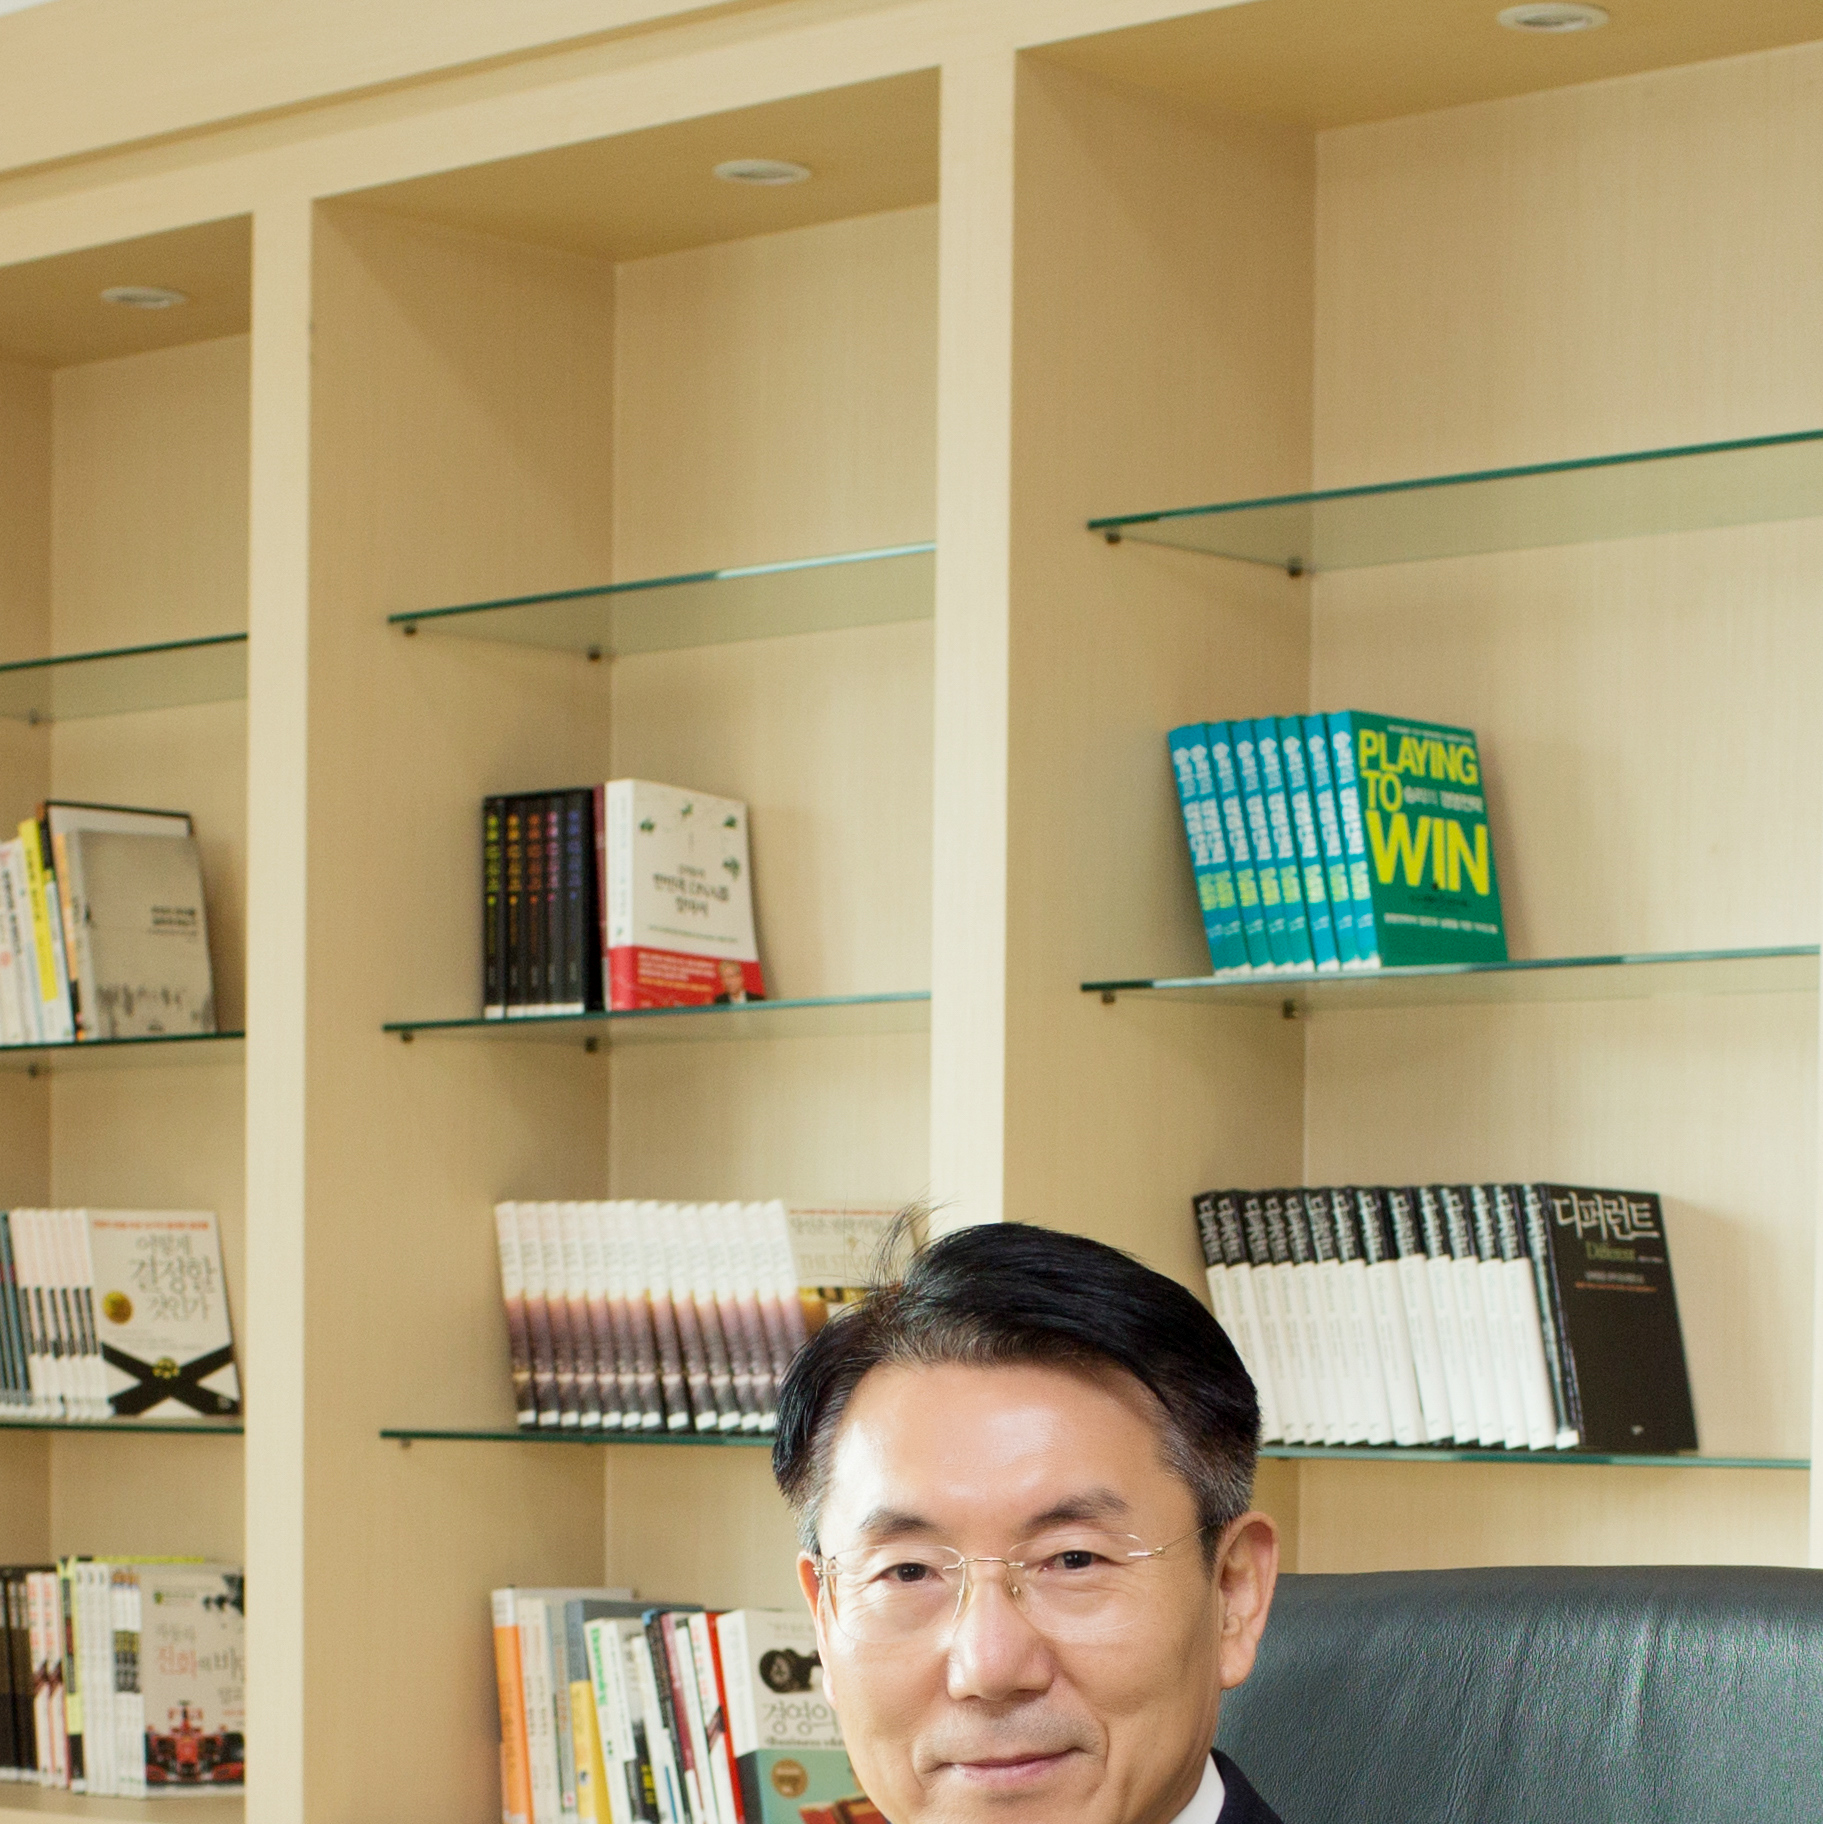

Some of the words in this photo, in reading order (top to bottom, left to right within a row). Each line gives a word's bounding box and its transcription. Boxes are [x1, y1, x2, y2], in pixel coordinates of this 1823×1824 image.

[1359, 729, 1478, 786] PLAYING
[1361, 769, 1403, 812] TO
[1366, 809, 1490, 896] WIN
[1552, 1190, 1661, 1241] 디퍼런트
